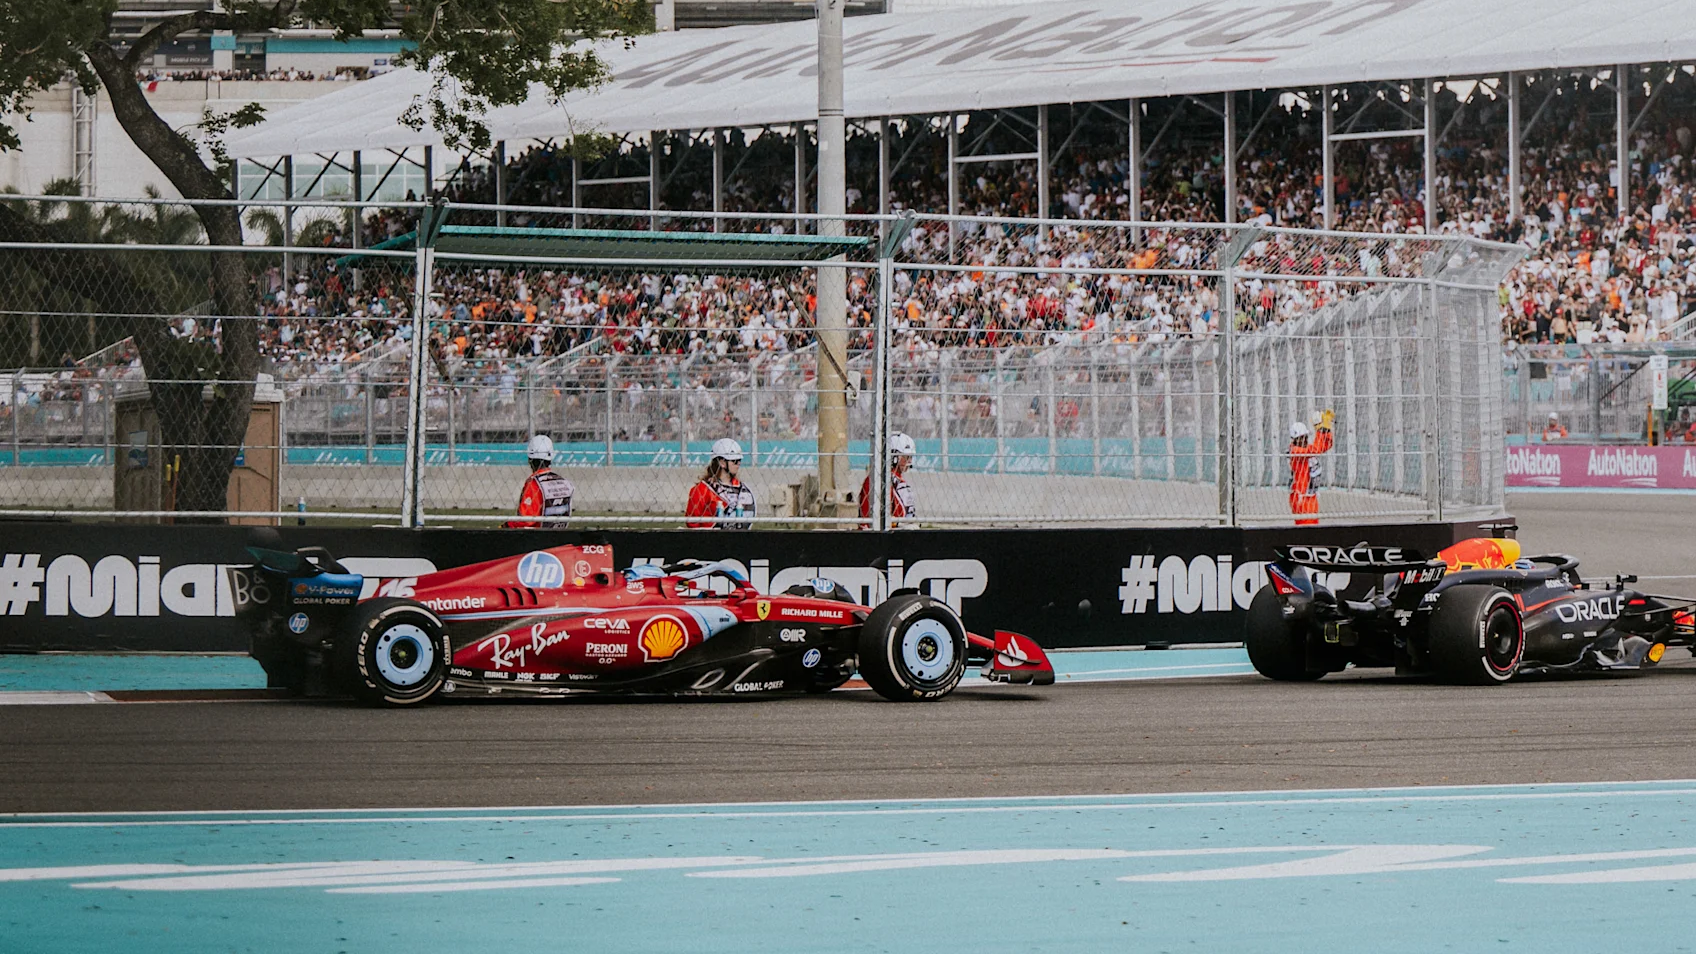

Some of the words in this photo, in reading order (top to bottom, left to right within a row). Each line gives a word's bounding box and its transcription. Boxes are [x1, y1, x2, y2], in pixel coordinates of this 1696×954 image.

[1587, 448, 1657, 476] AutoNation
[1289, 547, 1402, 564] ORACLE
[525, 551, 558, 588] hp
[308, 586, 354, 595] V-Power
[325, 597, 351, 605] POKER
[781, 608, 818, 617] RICHARD
[819, 609, 843, 619] MILLE
[291, 615, 308, 634] hp
[585, 642, 628, 654] PERONI
[733, 681, 763, 692] GLOBAL
